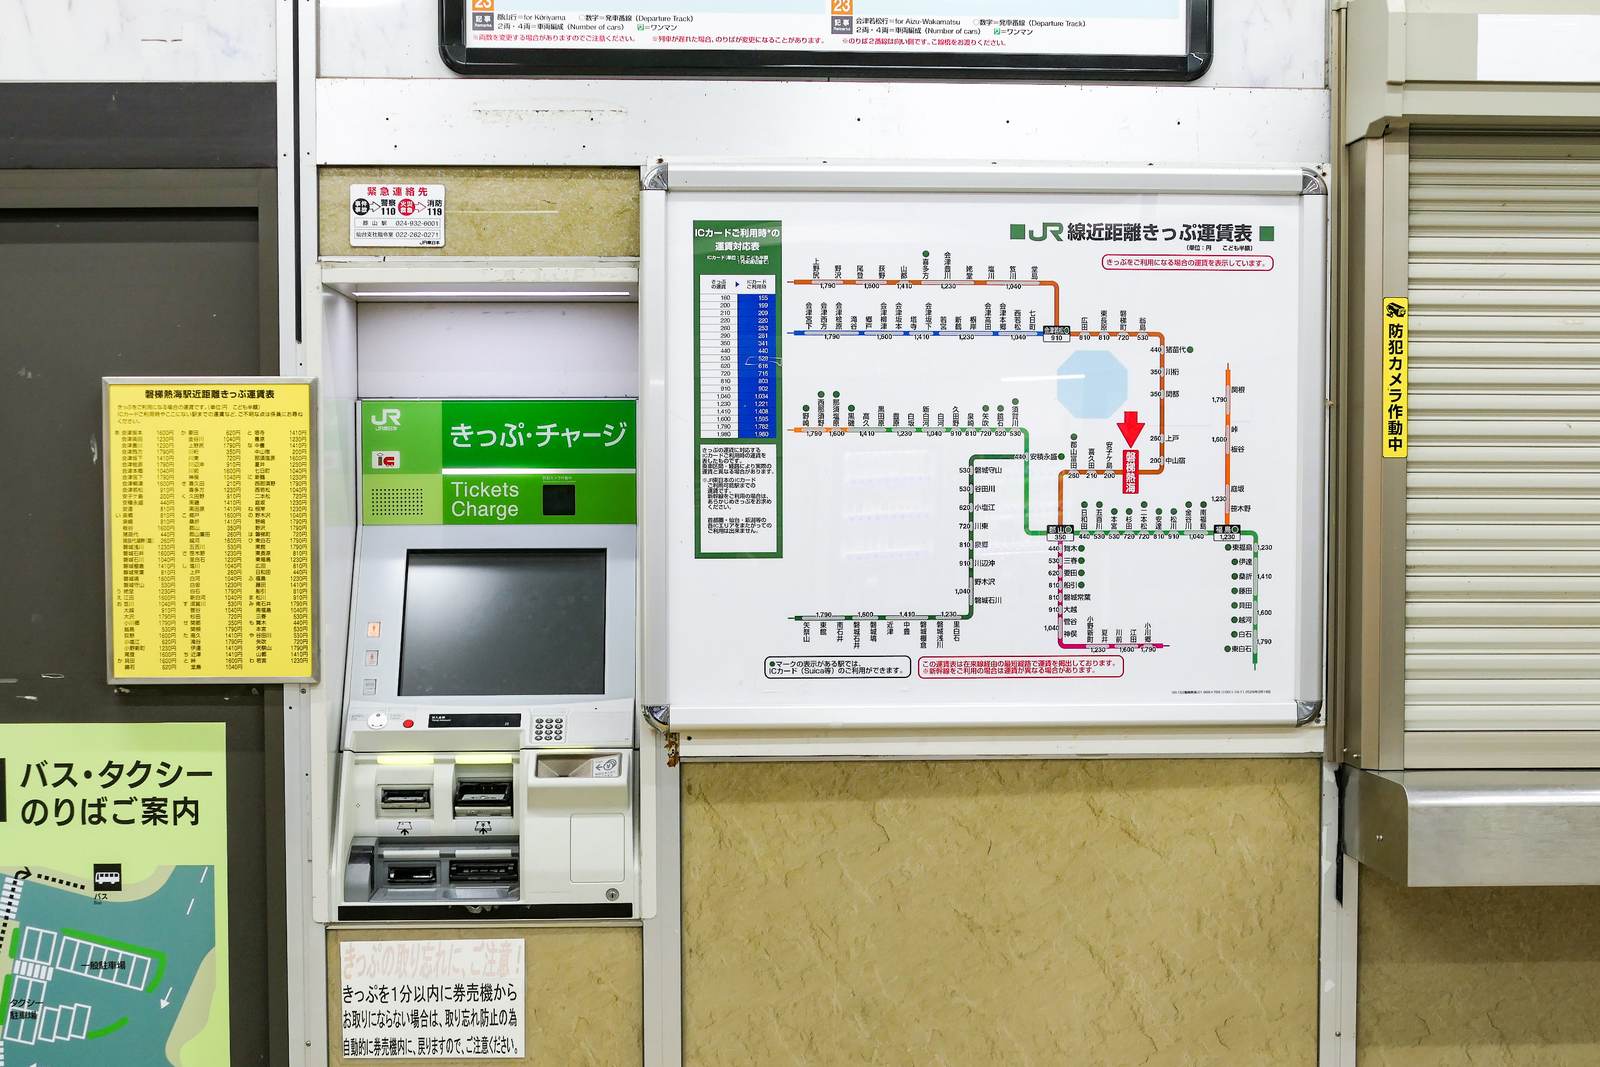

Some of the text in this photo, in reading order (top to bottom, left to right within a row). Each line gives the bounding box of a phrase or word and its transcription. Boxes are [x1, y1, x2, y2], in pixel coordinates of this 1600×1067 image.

[836, 0, 852, 12] 23
[367, 186, 428, 197] 緊急連絡先
[381, 207, 396, 216] 110
[427, 199, 443, 207] 消防
[428, 207, 443, 216] 119
[1165, 346, 1187, 354] 猪苗代
[144, 389, 275, 399] 磐梯熱海駅近距離きっぷ運賃表
[1387, 323, 1404, 452] 防犯カメラ作動中
[371, 408, 401, 426] JR
[450, 422, 627, 448] きっぷ・チャージ
[1030, 453, 1058, 461] 安積永盛
[450, 481, 519, 498] Tickets
[451, 500, 519, 521] Charge
[20, 759, 213, 789] バス・タクシー
[21, 796, 199, 826] のりばご案内
[342, 982, 518, 1004] きっぷを1分以内に券売機から
[342, 1008, 518, 1029] お取りにならない場合は、取り忘れ防止の為
[343, 1035, 519, 1056] 自動的に券売機内に、戻りますので、ご注意ください。
